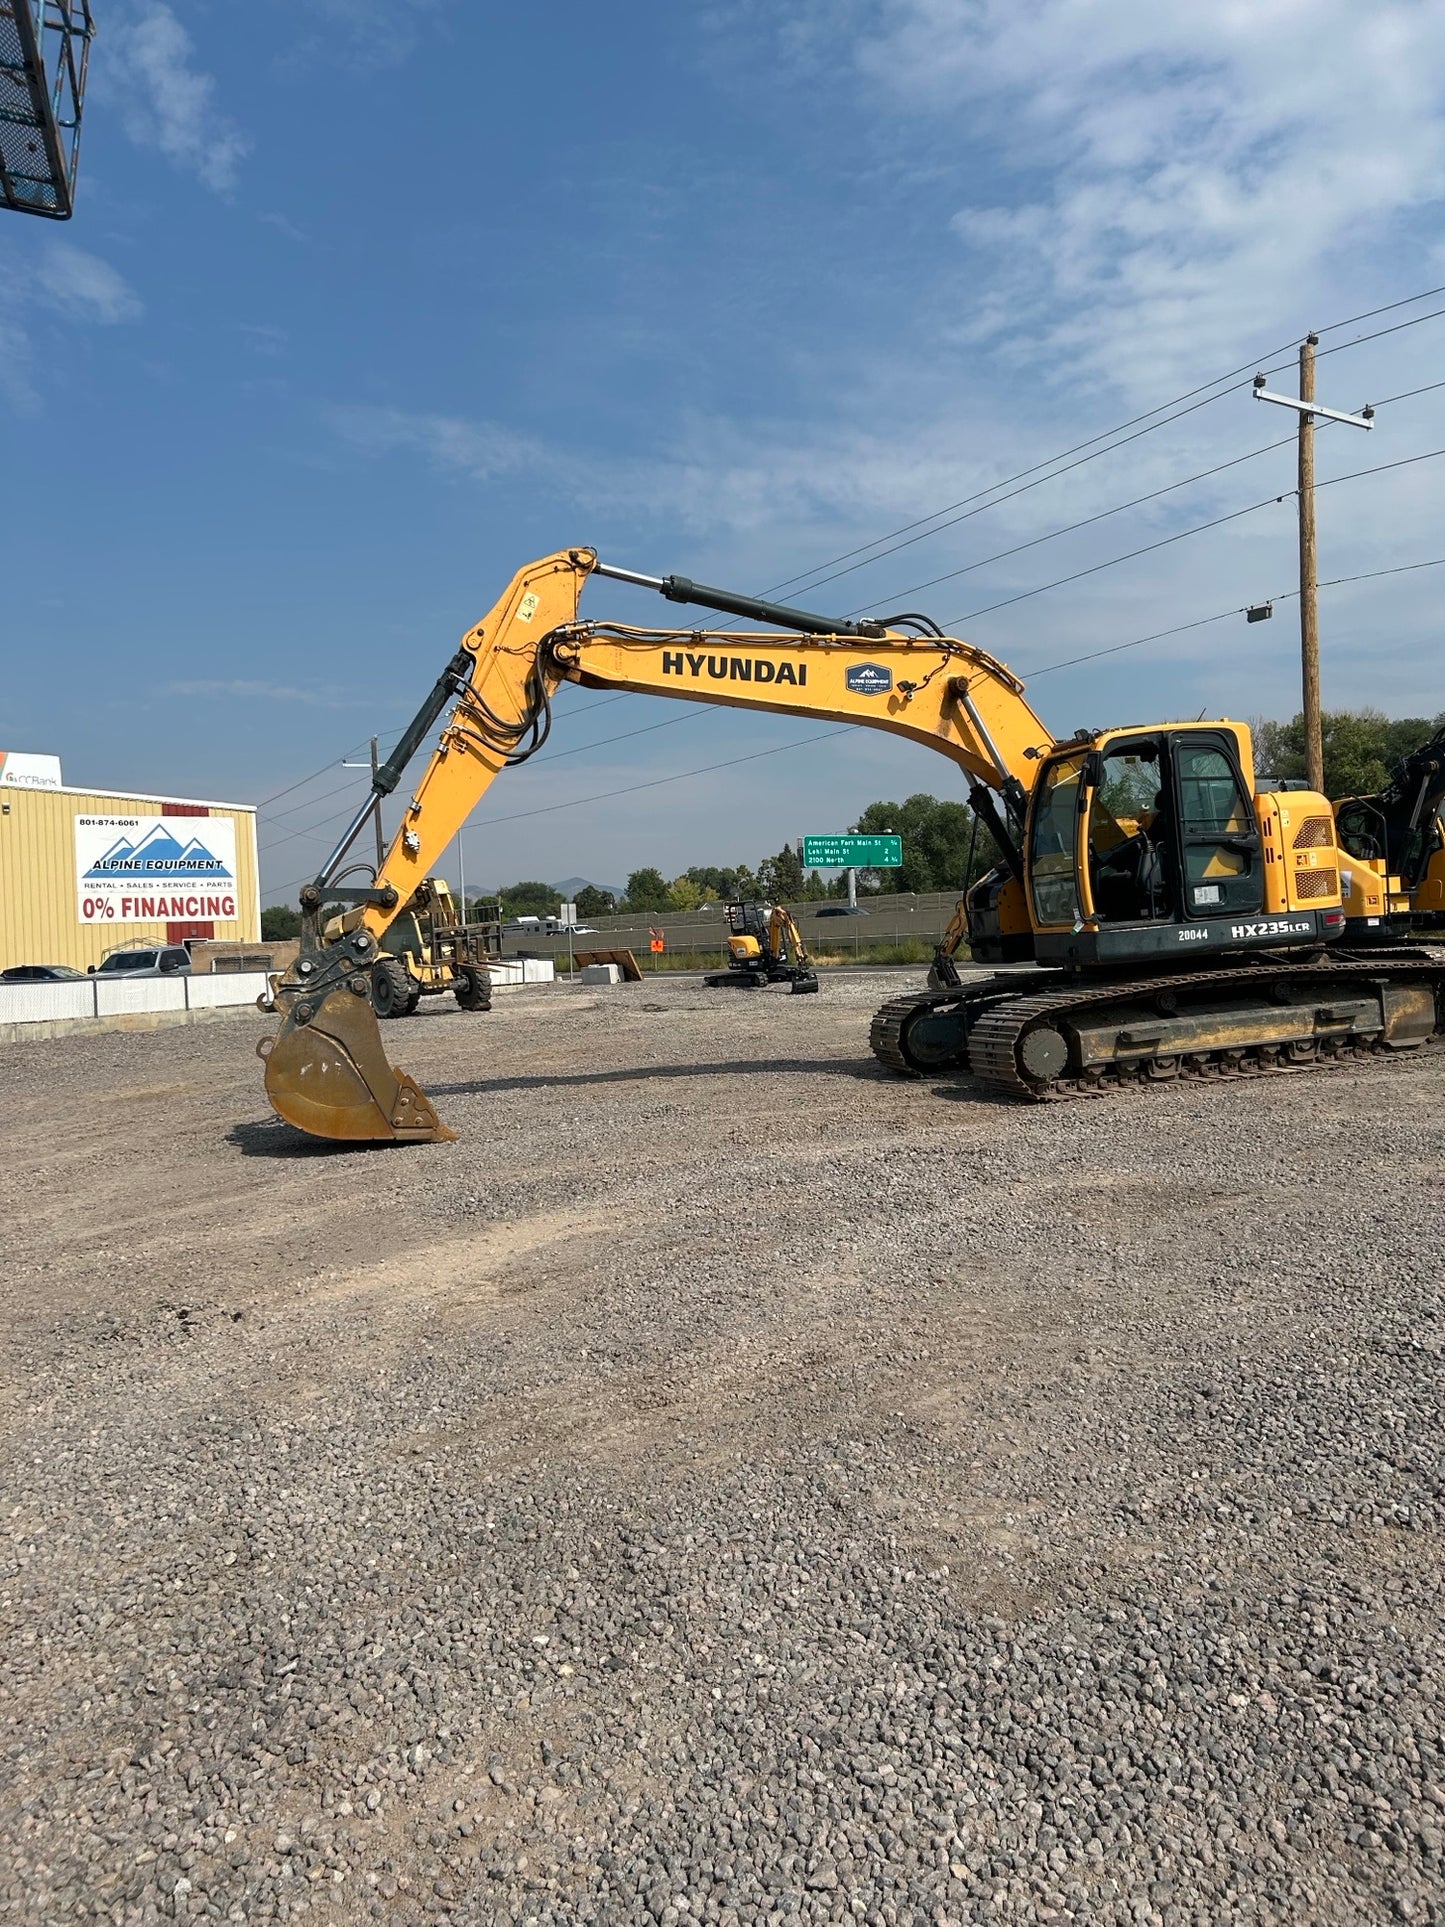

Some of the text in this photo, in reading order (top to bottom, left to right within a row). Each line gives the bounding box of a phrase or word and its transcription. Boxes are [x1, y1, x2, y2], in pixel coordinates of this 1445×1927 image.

[662, 651, 807, 686] HYUNDAI
[79, 818, 139, 827] 801-874-6061
[808, 839, 839, 847] American
[840, 839, 855, 847] Fork
[92, 860, 223, 871] ALPINE EQUIPMENT
[808, 856, 824, 864] 2100
[83, 896, 236, 919] 0% FINANCING
[1178, 928, 1209, 942] 20044
[1231, 920, 1311, 939] HX235LCR
